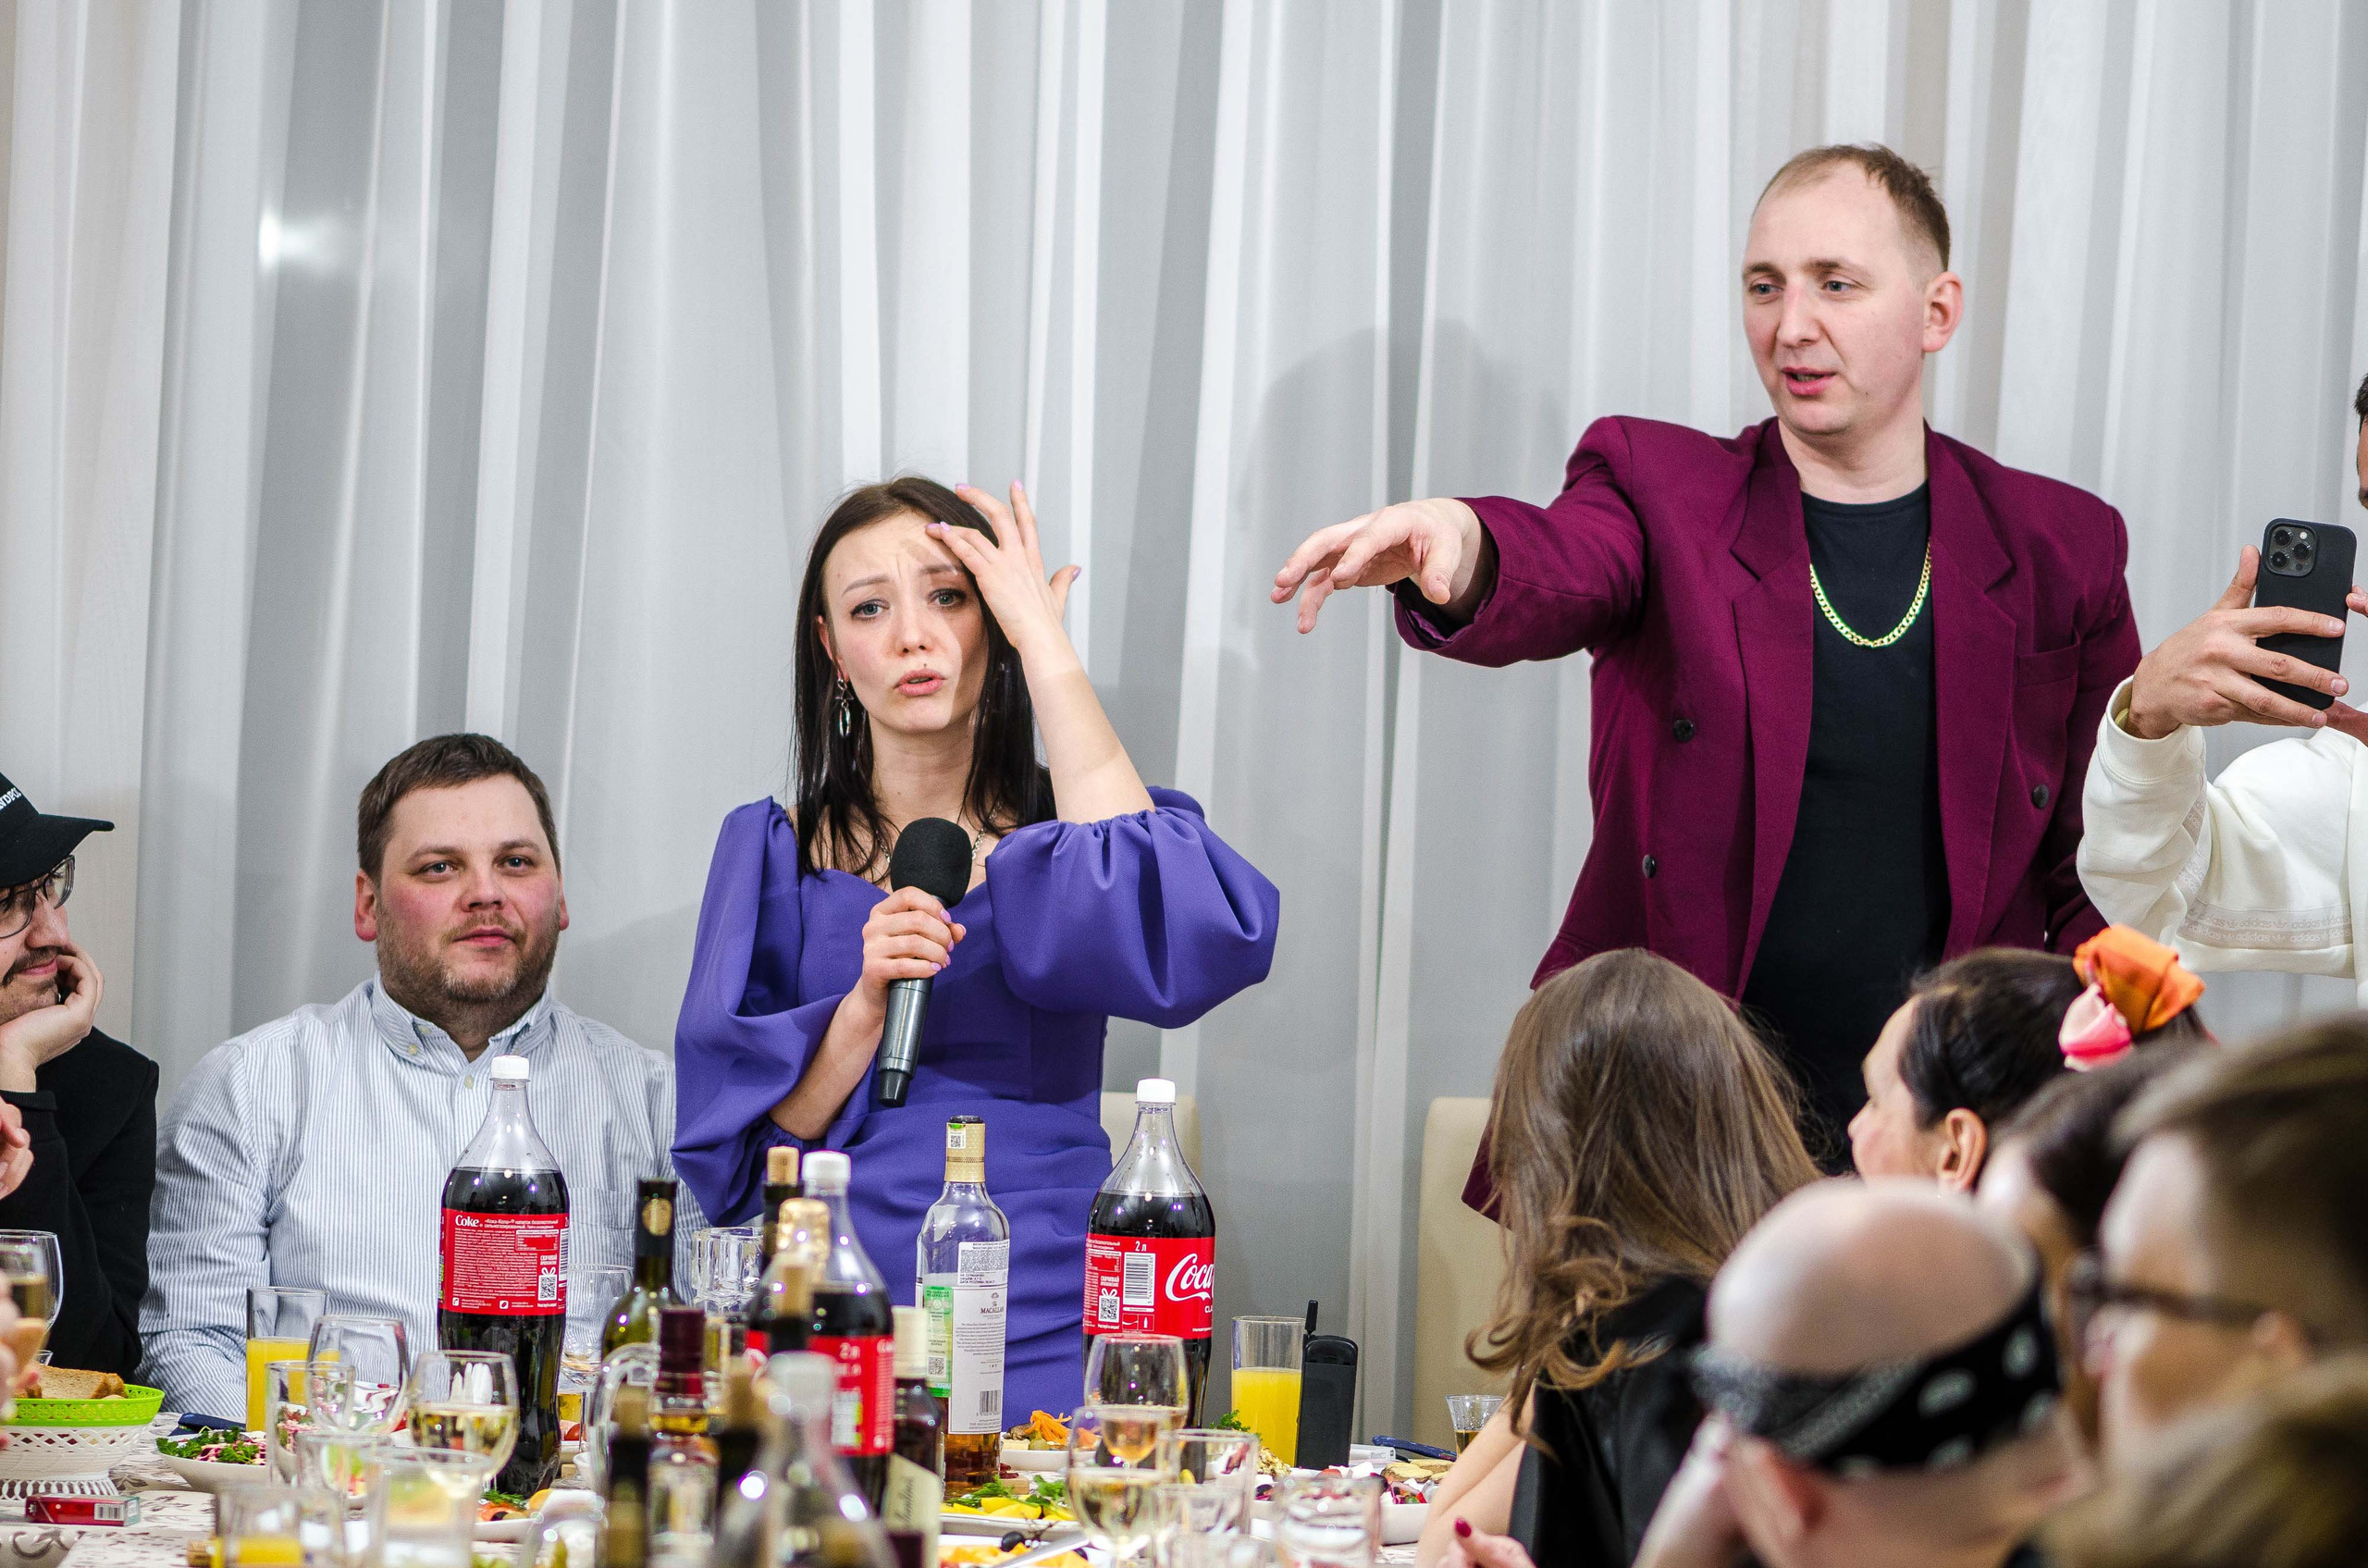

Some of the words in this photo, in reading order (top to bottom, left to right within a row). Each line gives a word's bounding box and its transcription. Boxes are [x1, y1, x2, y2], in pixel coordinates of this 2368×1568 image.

[2236, 931, 2271, 943] adidas
[455, 1215, 479, 1227] Coke
[1135, 1241, 1141, 1252] 2
